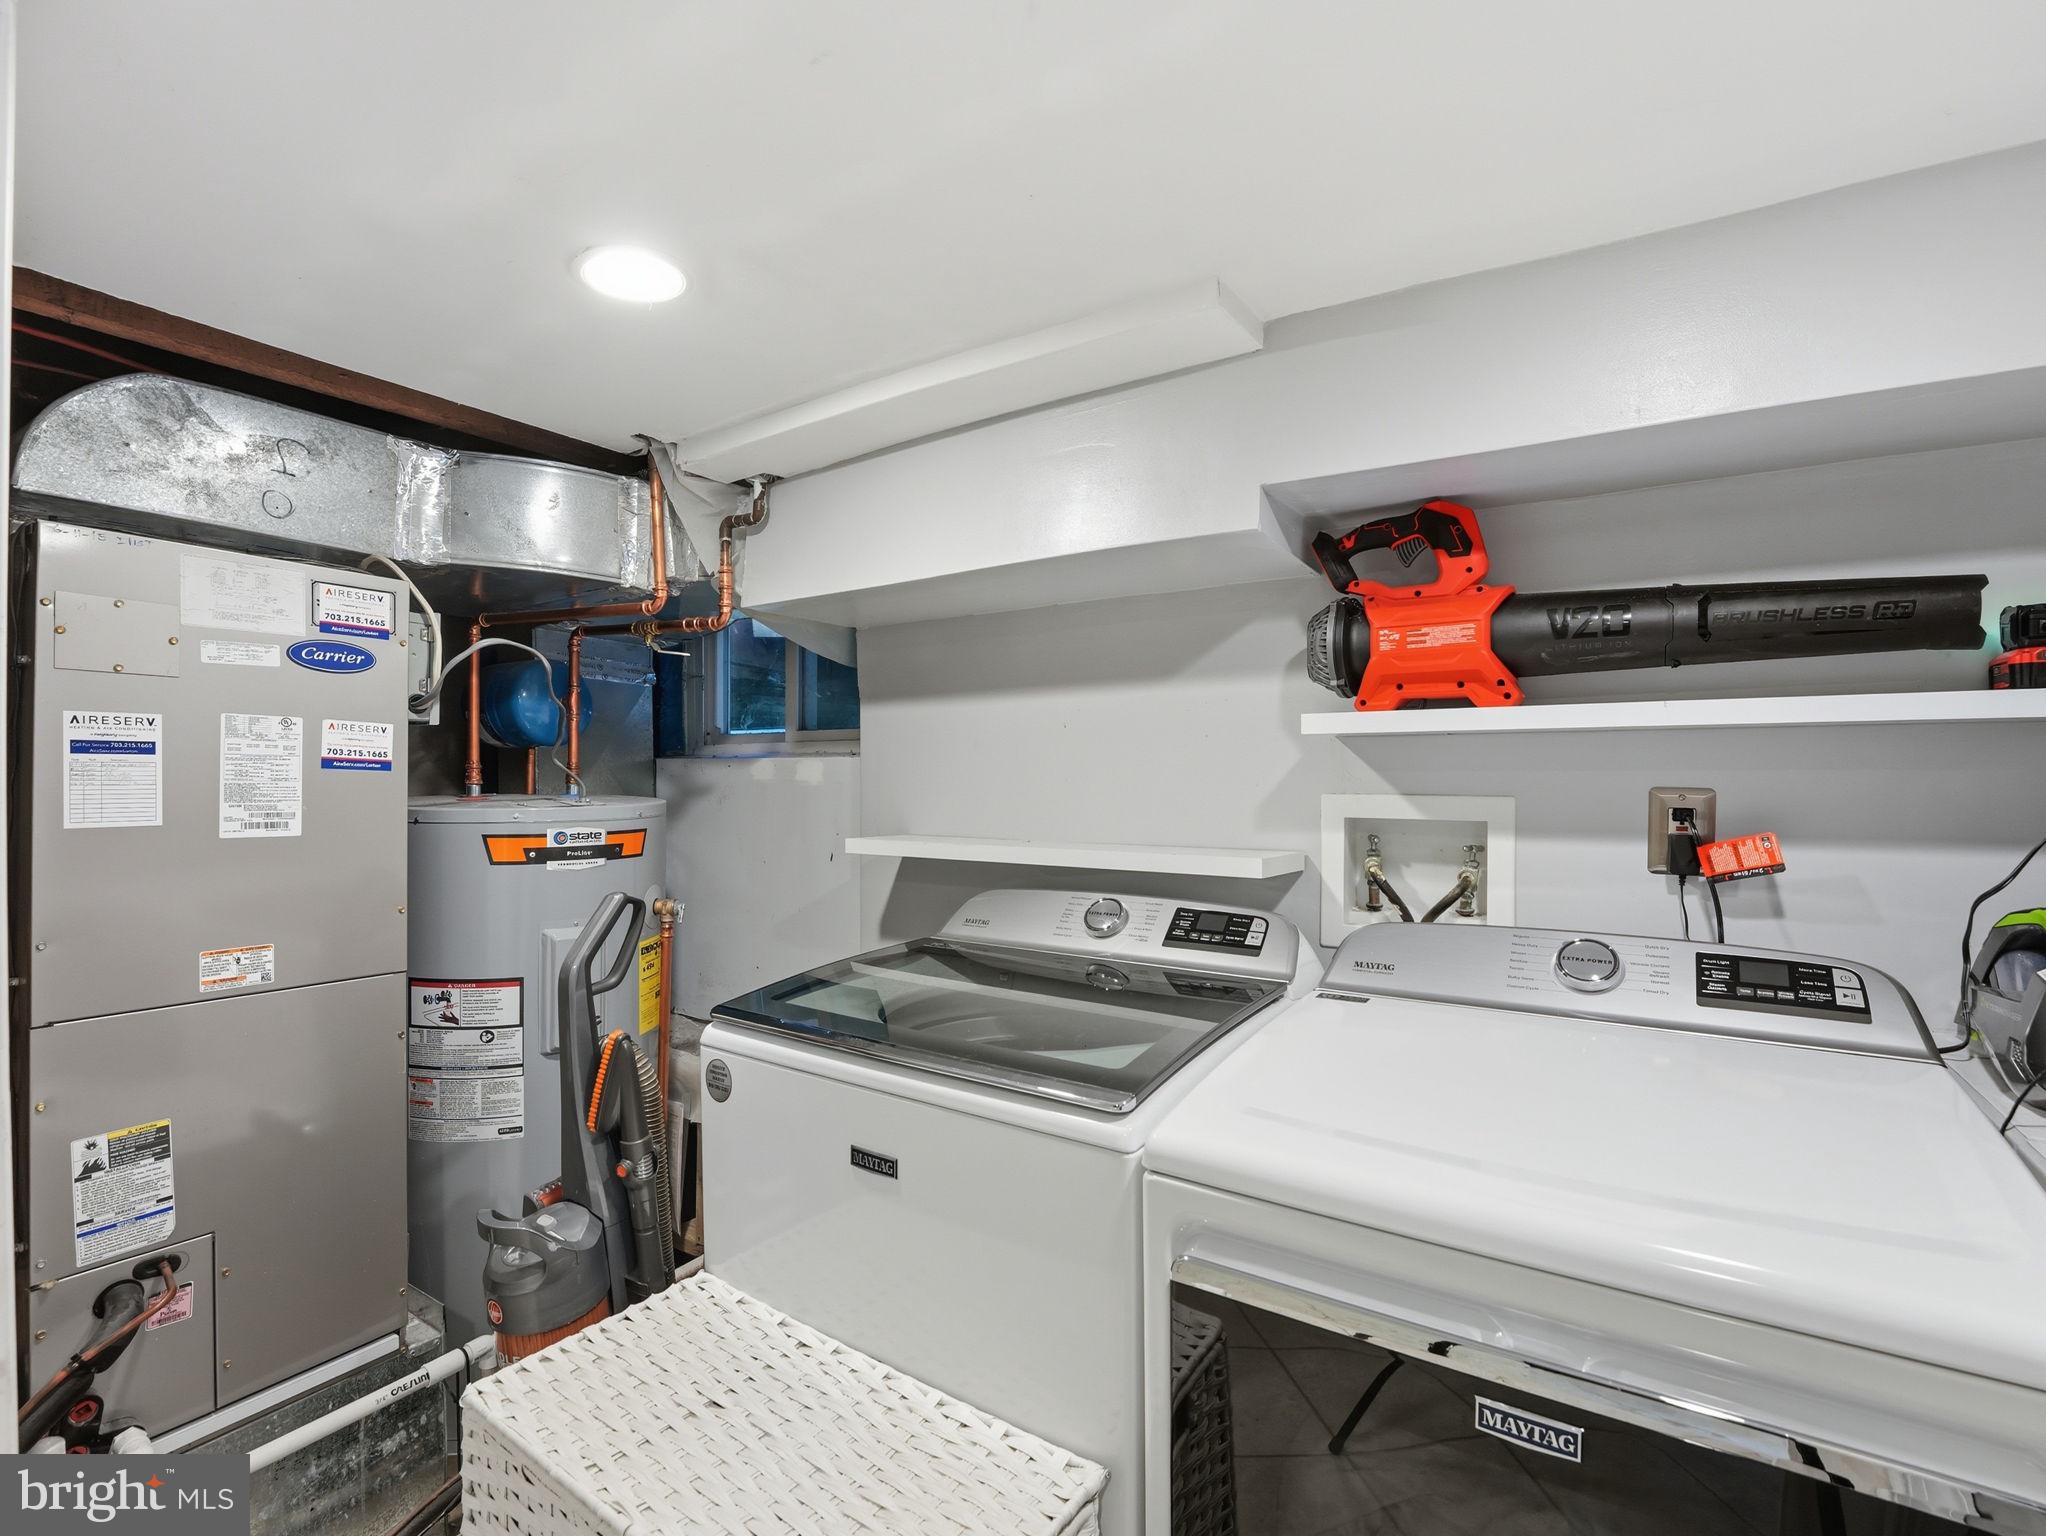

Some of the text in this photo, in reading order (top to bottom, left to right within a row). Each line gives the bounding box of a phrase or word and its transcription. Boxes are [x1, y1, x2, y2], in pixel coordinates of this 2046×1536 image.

[325, 588, 384, 603] AIRESERV
[324, 612, 386, 627] 703.215.1665
[1546, 603, 1632, 640] V20
[1712, 604, 1867, 626] BRUSHLESS
[301, 646, 365, 664] Carrier
[69, 714, 156, 726] AIRESERV
[328, 723, 388, 734] AIRESERV
[326, 748, 388, 758] 703.215.1665
[568, 831, 602, 841] state
[1354, 961, 1395, 971] MAYTAG
[853, 1151, 894, 1174] MAYTAG
[1480, 1407, 1576, 1454] MAYTAG
